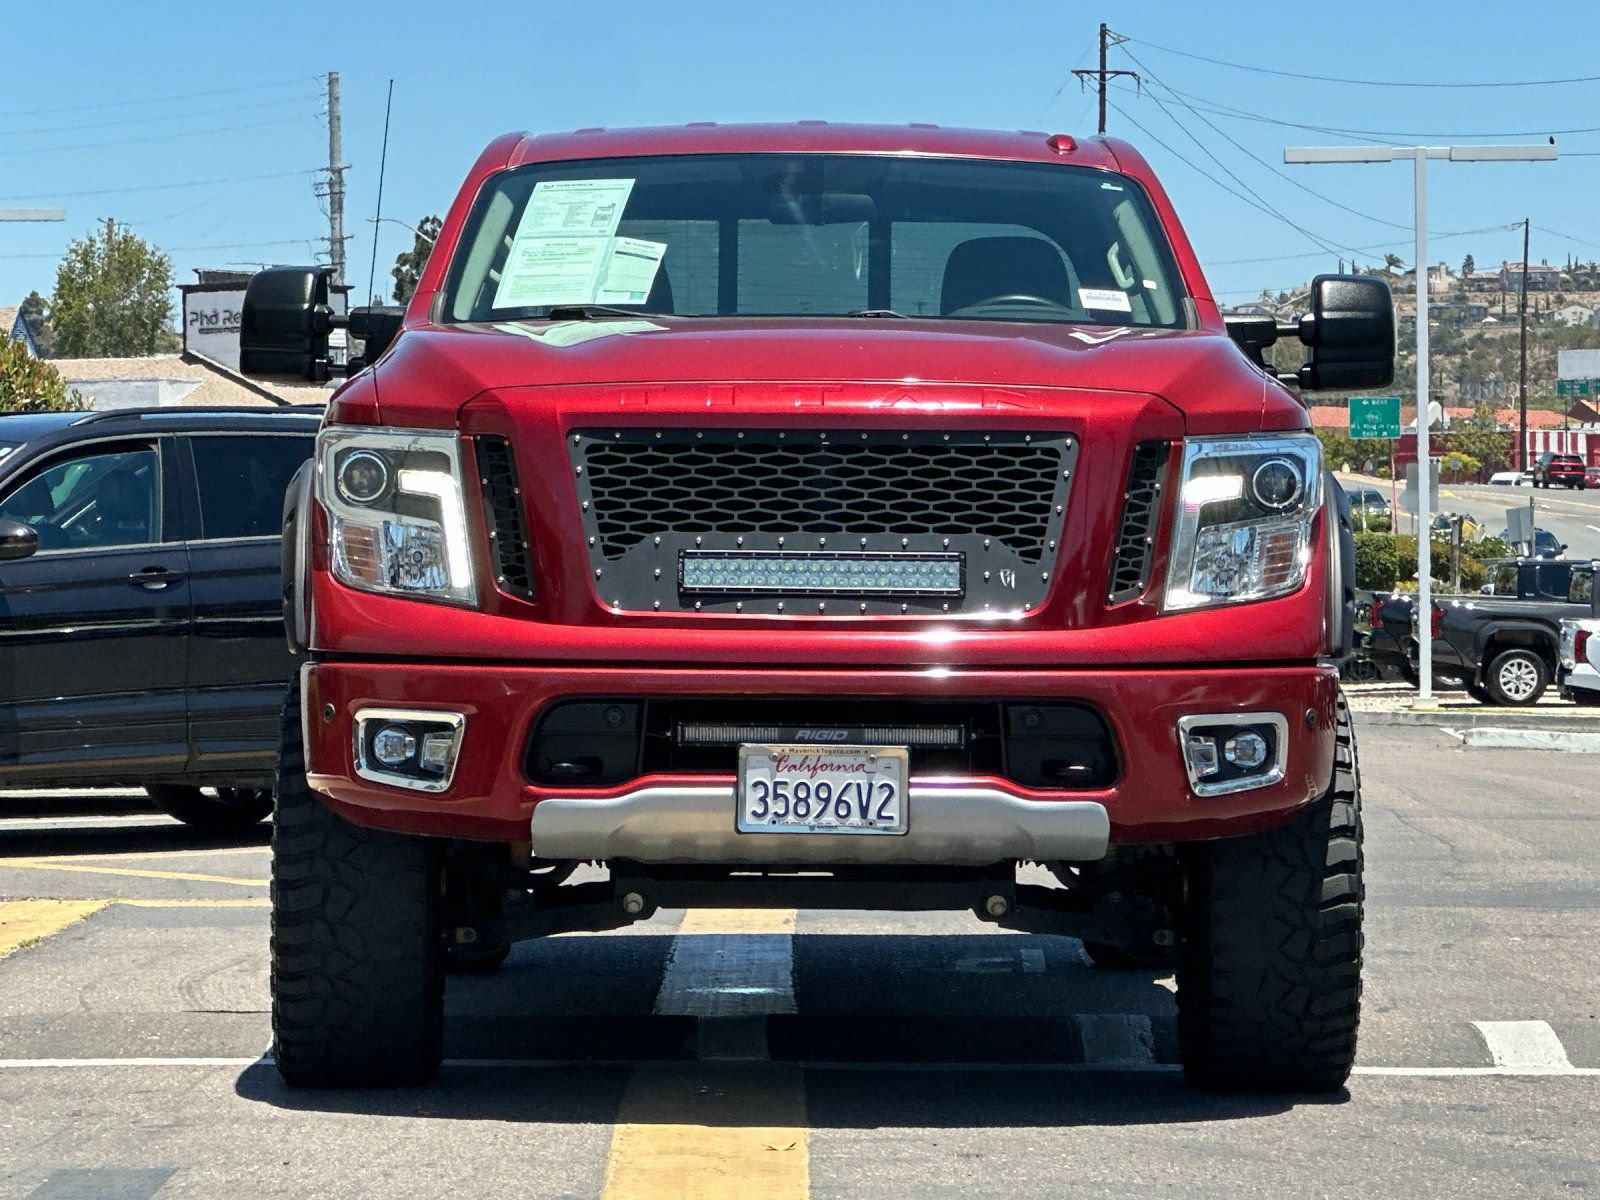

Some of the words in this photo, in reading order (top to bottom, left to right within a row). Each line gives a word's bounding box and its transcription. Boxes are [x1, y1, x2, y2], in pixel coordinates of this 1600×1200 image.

[606, 384, 1043, 408] TITAN
[794, 729, 849, 741] RIGID
[775, 755, 876, 779] California
[751, 780, 895, 820] 35896V2
